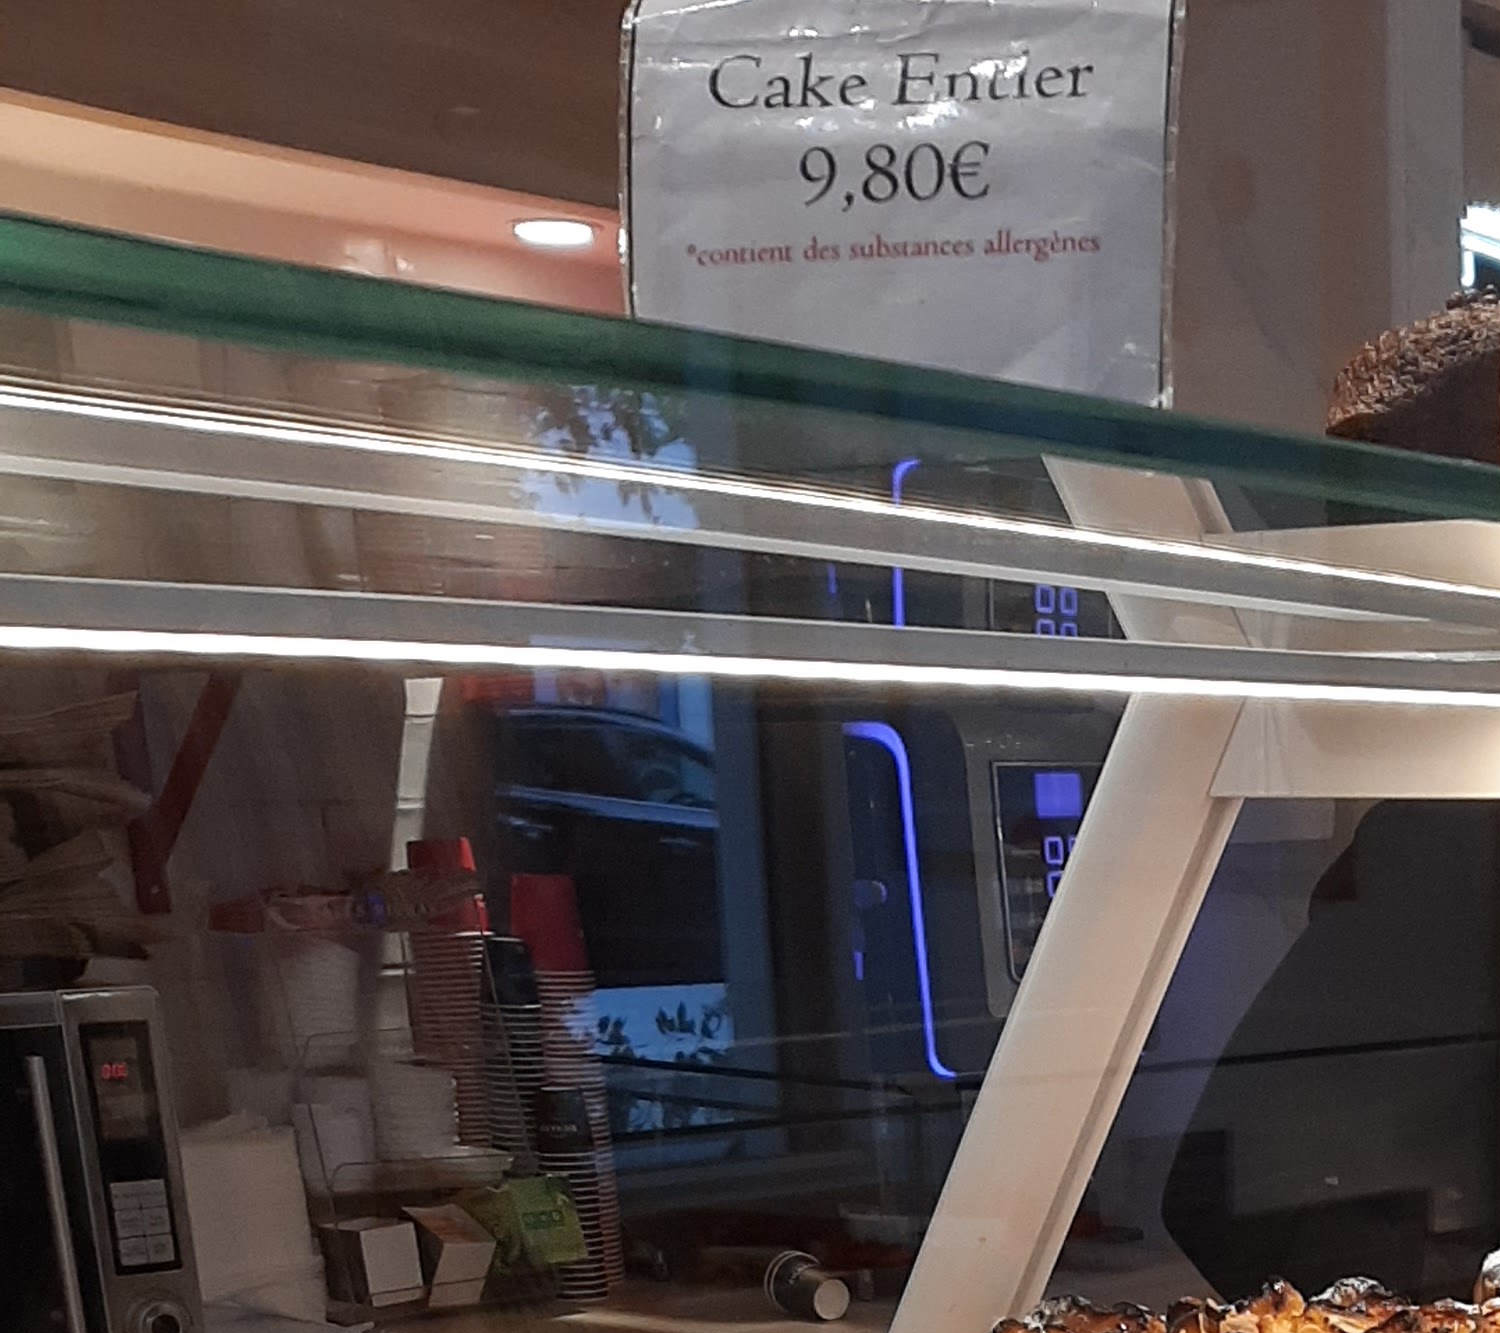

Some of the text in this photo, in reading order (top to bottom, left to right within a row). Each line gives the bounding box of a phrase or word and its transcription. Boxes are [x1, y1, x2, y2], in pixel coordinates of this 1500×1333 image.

[709, 49, 1096, 110] Cake Entier
[799, 140, 990, 212] 9,80€
[803, 235, 841, 261] des
[848, 233, 975, 261] substances
[983, 229, 1101, 263] allergènes
